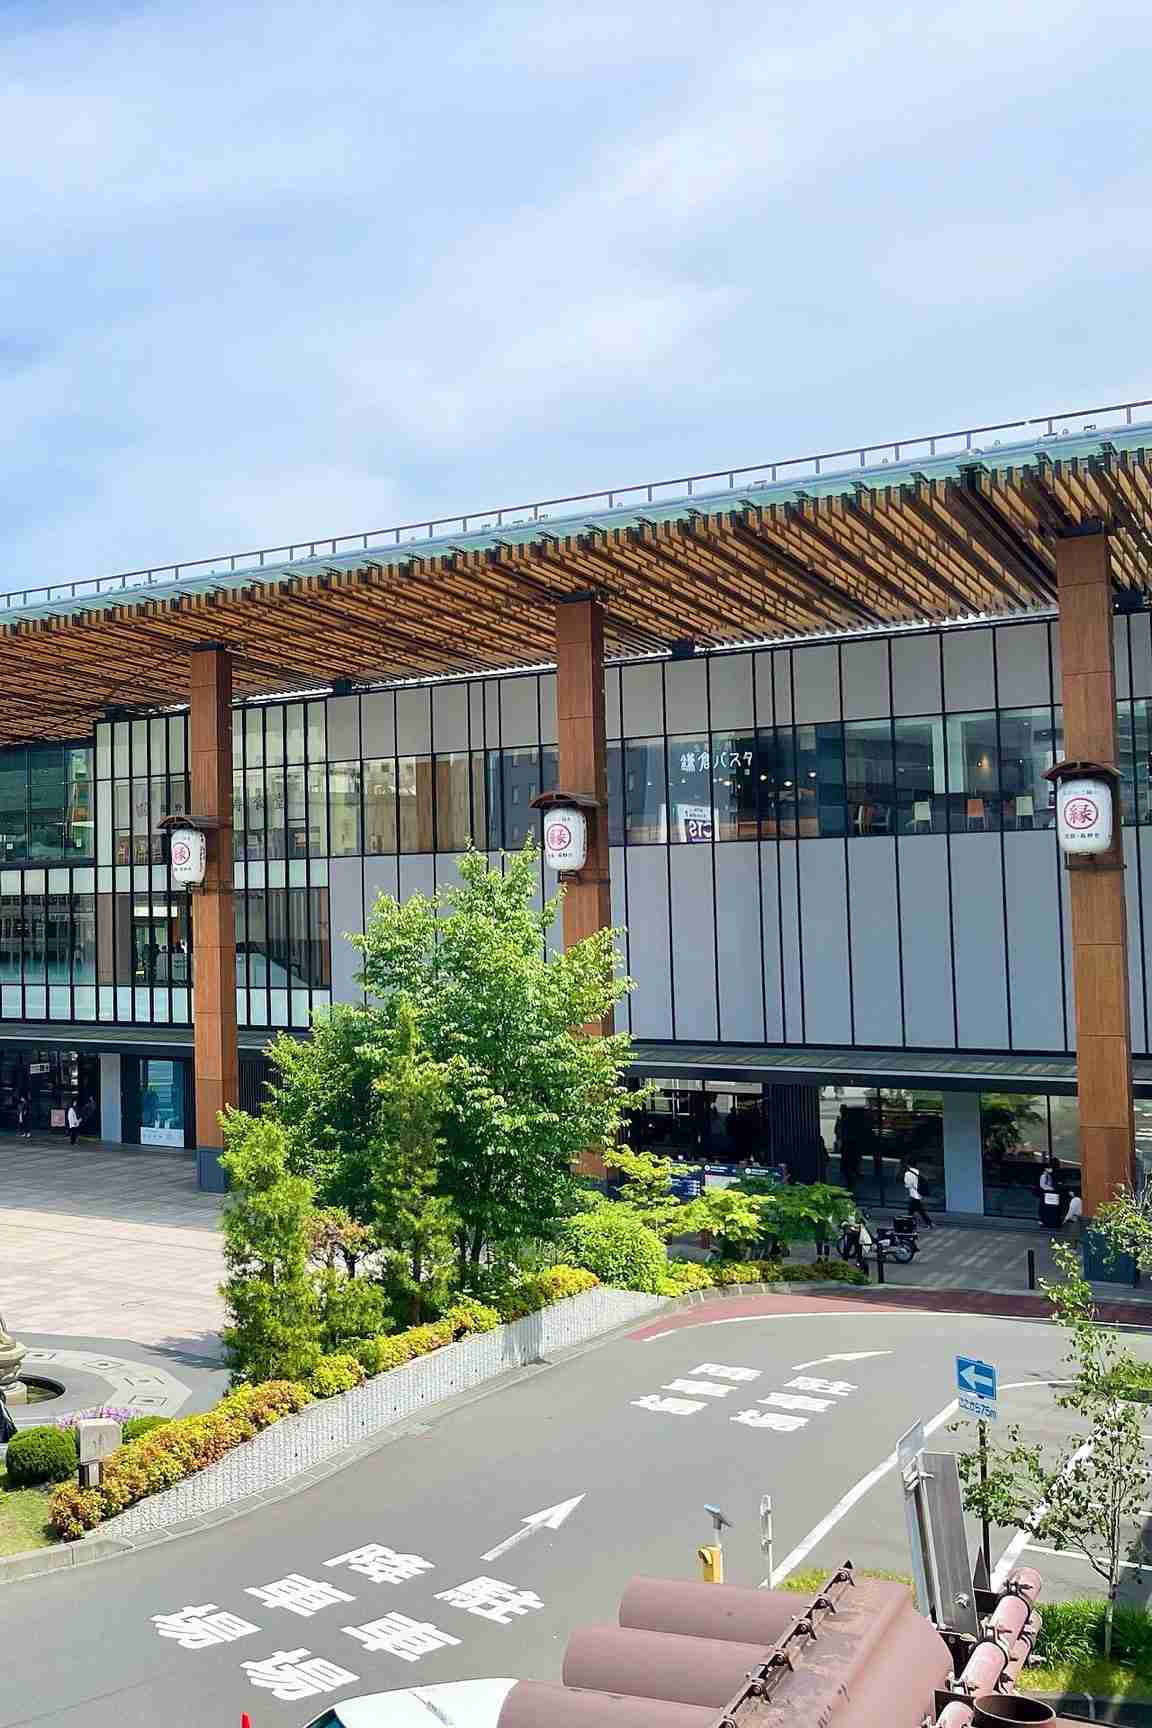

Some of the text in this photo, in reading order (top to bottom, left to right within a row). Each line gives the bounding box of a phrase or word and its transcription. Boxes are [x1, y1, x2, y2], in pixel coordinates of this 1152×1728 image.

[680, 752, 753, 773] 鎌倉パスタ
[240, 1575, 546, 1701] 駐車場
